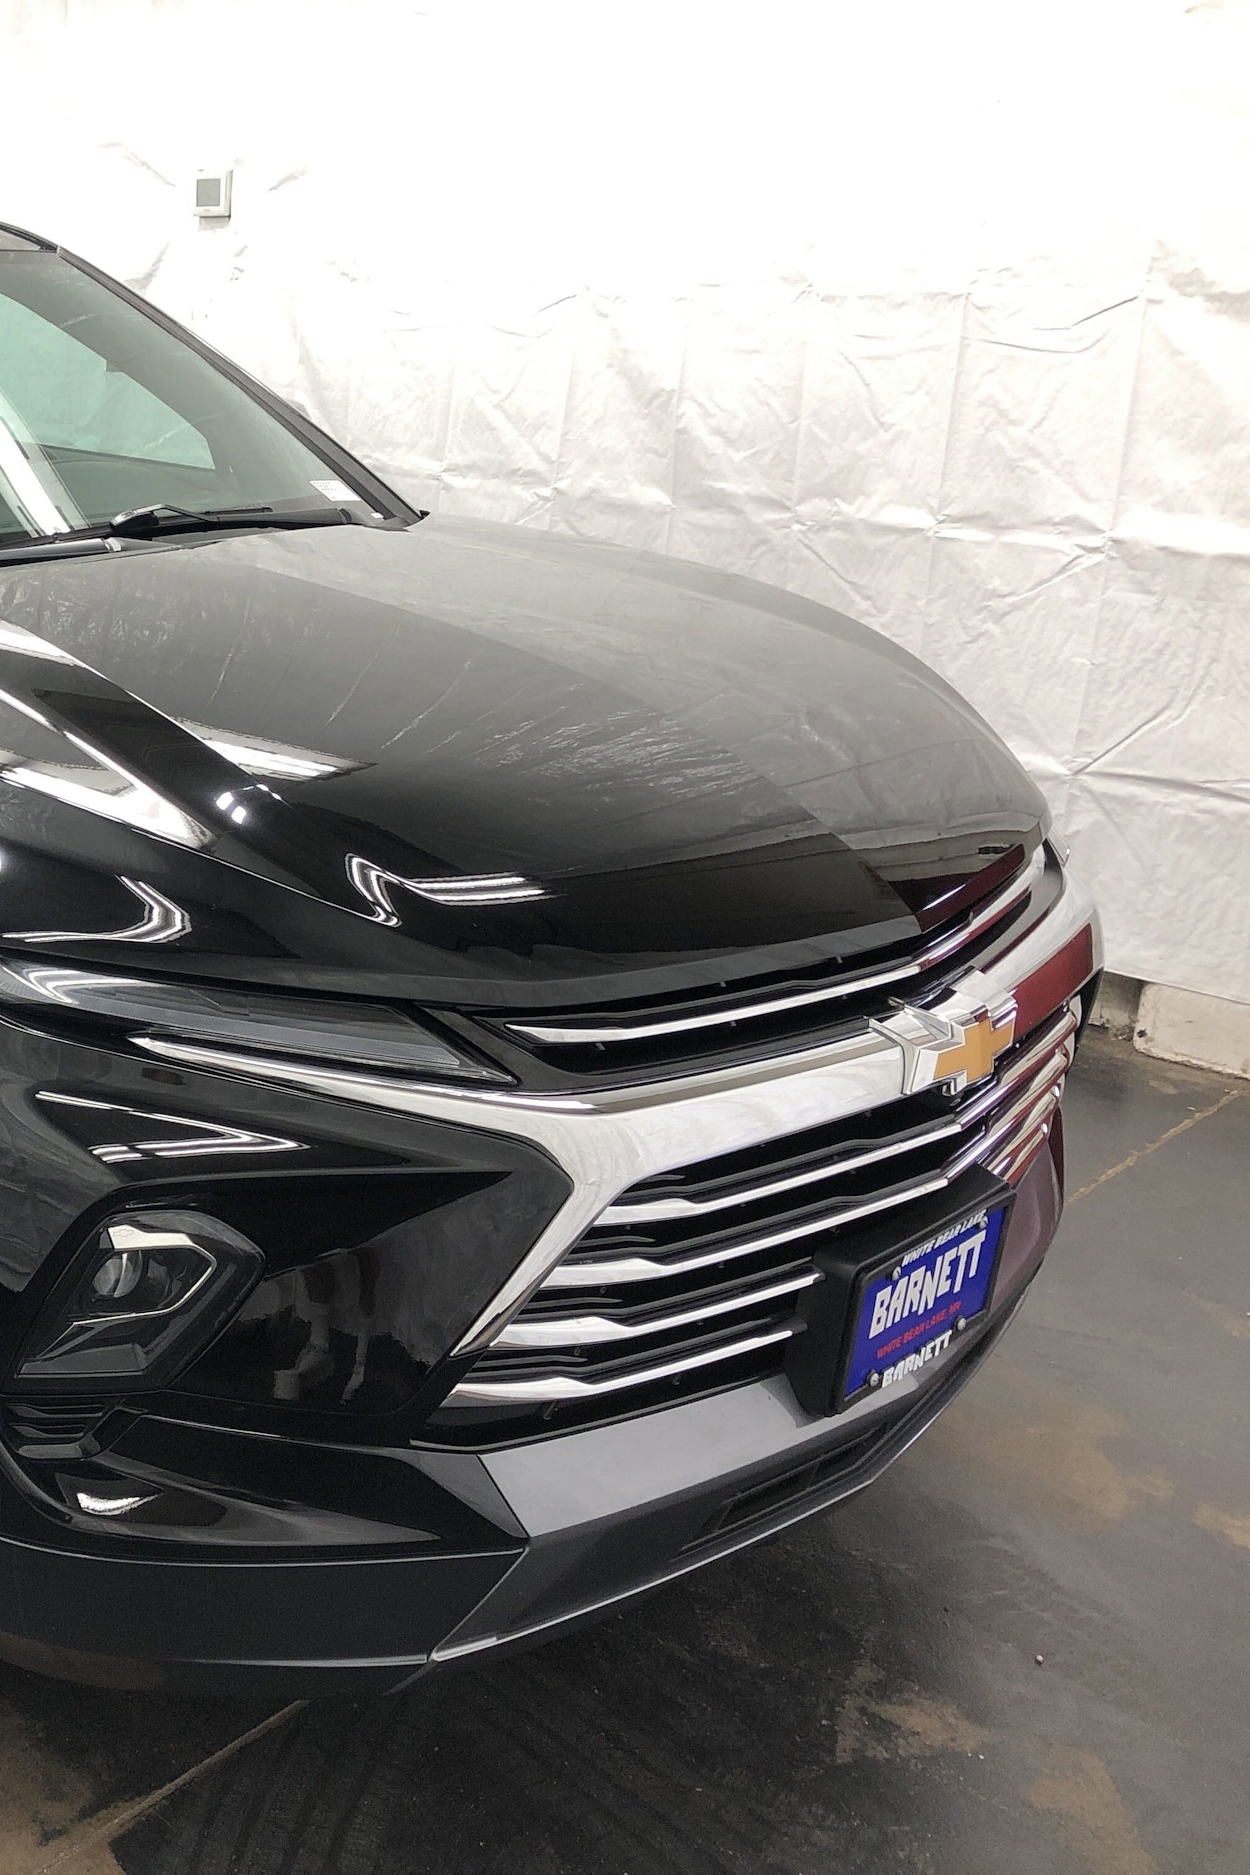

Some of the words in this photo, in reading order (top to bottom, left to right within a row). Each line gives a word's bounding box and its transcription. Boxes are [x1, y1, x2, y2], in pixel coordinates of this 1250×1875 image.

[901, 1239, 935, 1267] WHITE
[934, 1224, 961, 1250] BEAR
[960, 1209, 987, 1234] LAKE
[869, 1229, 987, 1340] BARNETT
[877, 1336, 903, 1359] WHITE
[903, 1322, 925, 1344] BEAR
[882, 1329, 952, 1388] BARNETT
